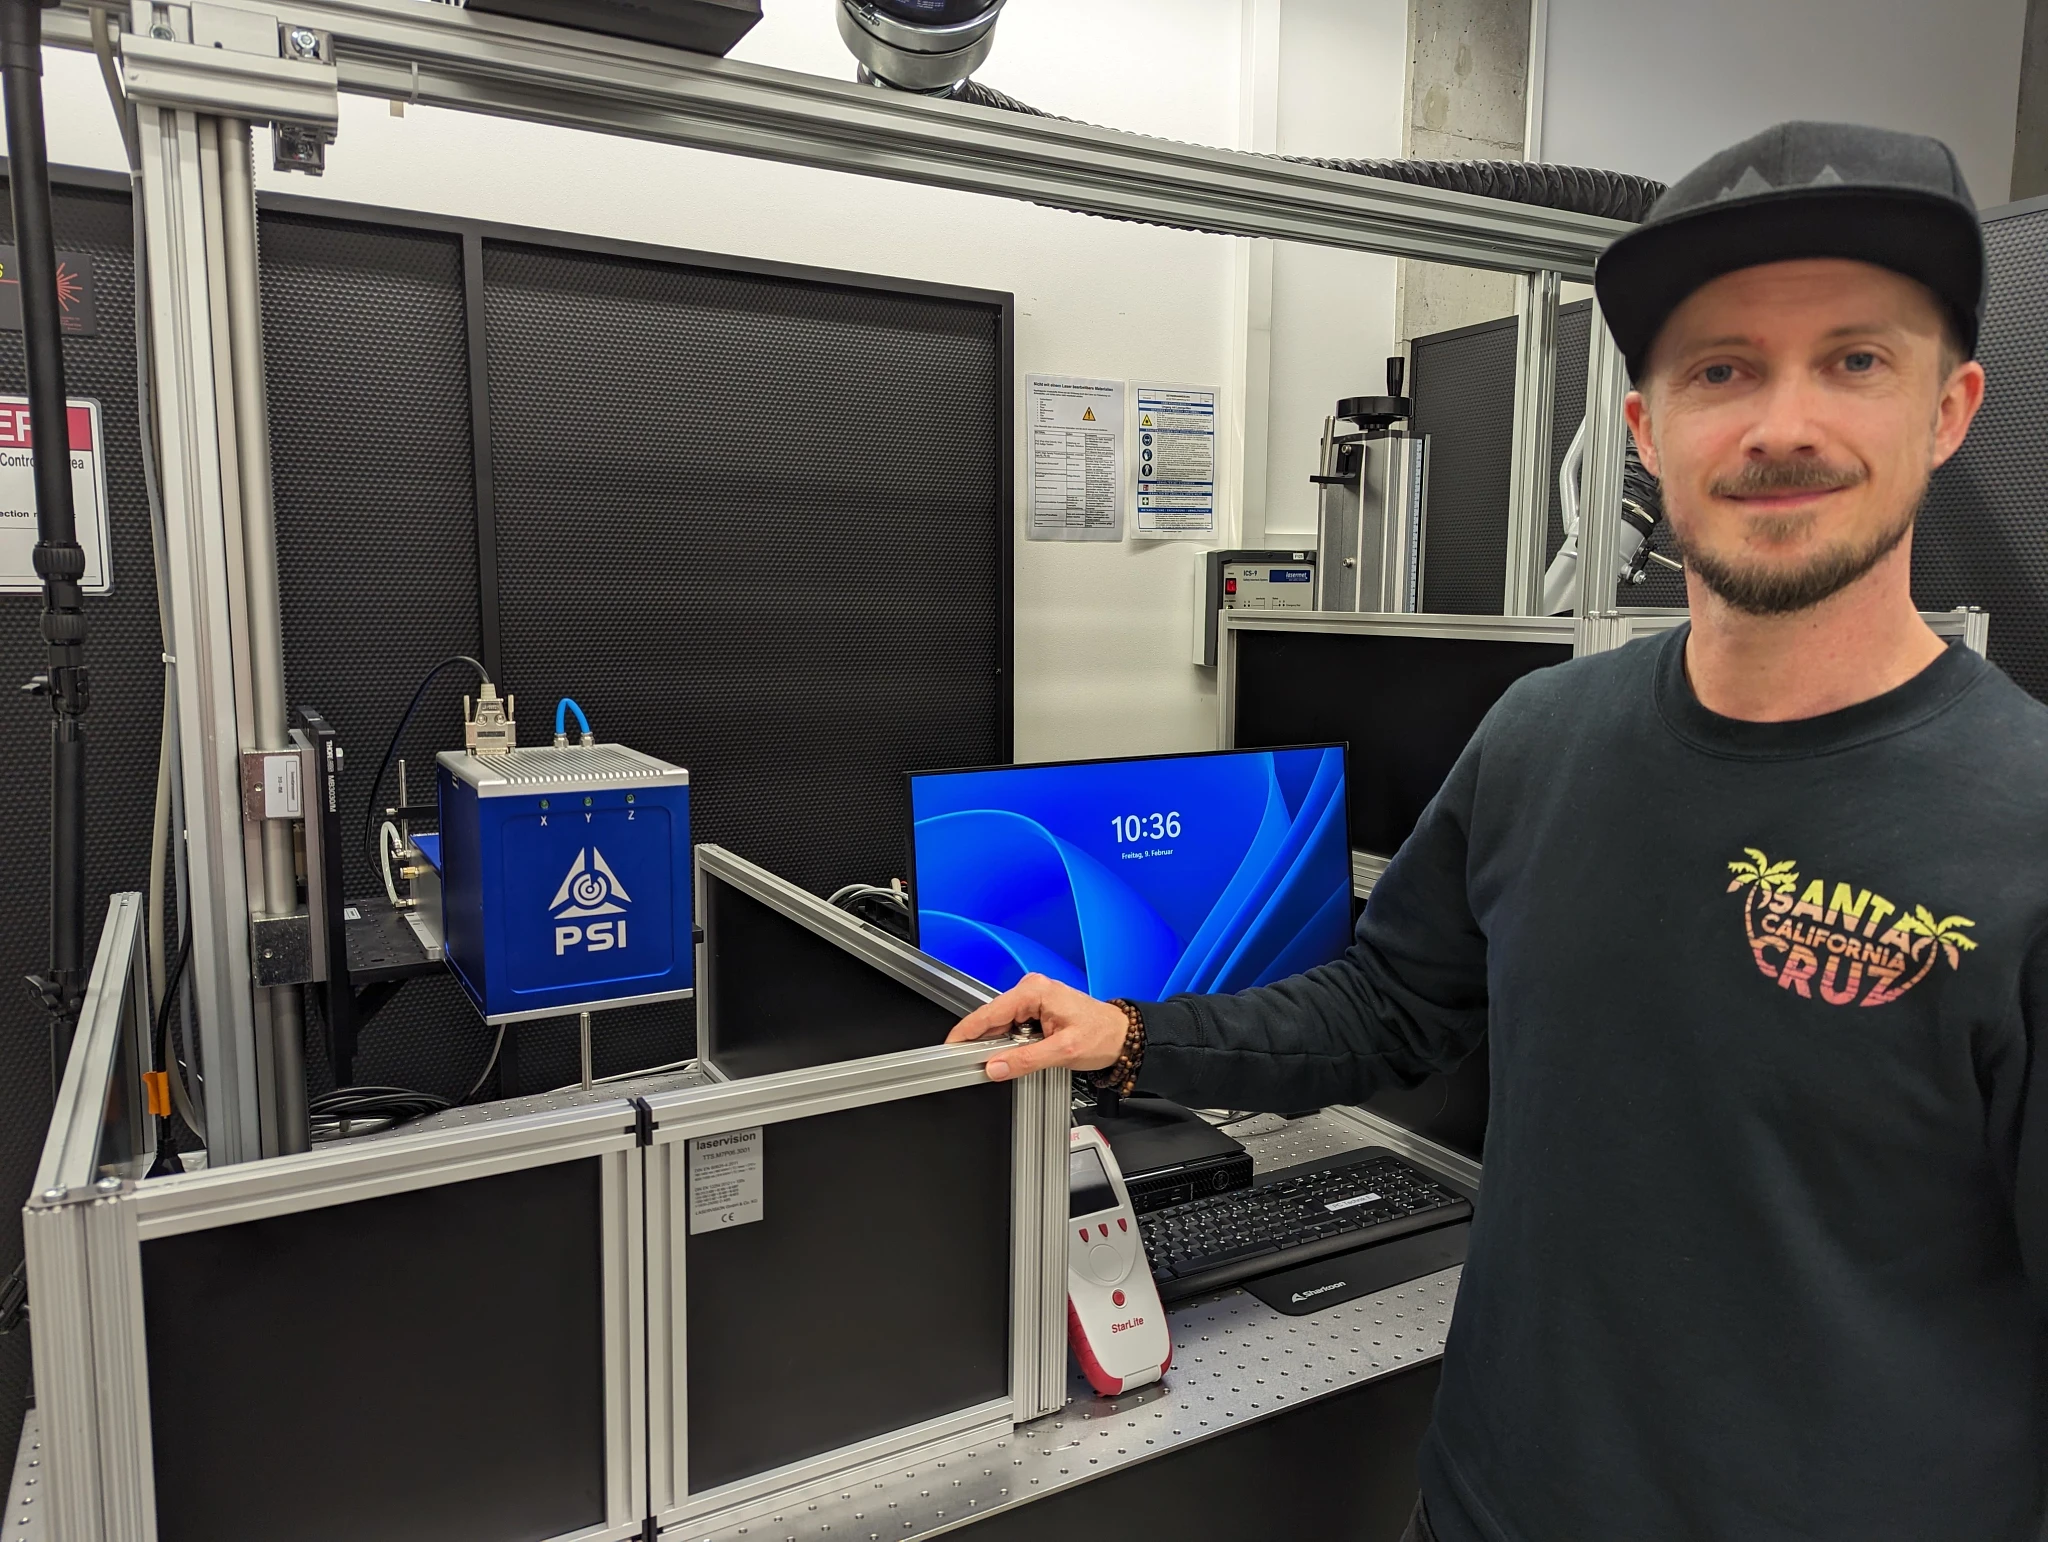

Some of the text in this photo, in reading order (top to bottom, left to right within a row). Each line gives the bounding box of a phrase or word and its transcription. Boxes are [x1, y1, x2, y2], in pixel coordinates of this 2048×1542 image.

[540, 815, 548, 827] X
[584, 812, 592, 823] Y
[627, 810, 635, 821] Z
[1111, 811, 1181, 843] 10:36
[1144, 850, 1151, 858] 9.
[1151, 849, 1174, 857] Februar
[1768, 879, 1912, 954] SANTA
[555, 920, 627, 956] PSI
[1761, 913, 1906, 972] CALIFORNIA
[1751, 935, 1906, 1007] CRUZ
[696, 1132, 757, 1151] laservision
[1302, 1281, 1347, 1298] Sharkoon
[1111, 1316, 1144, 1333] StarLite
